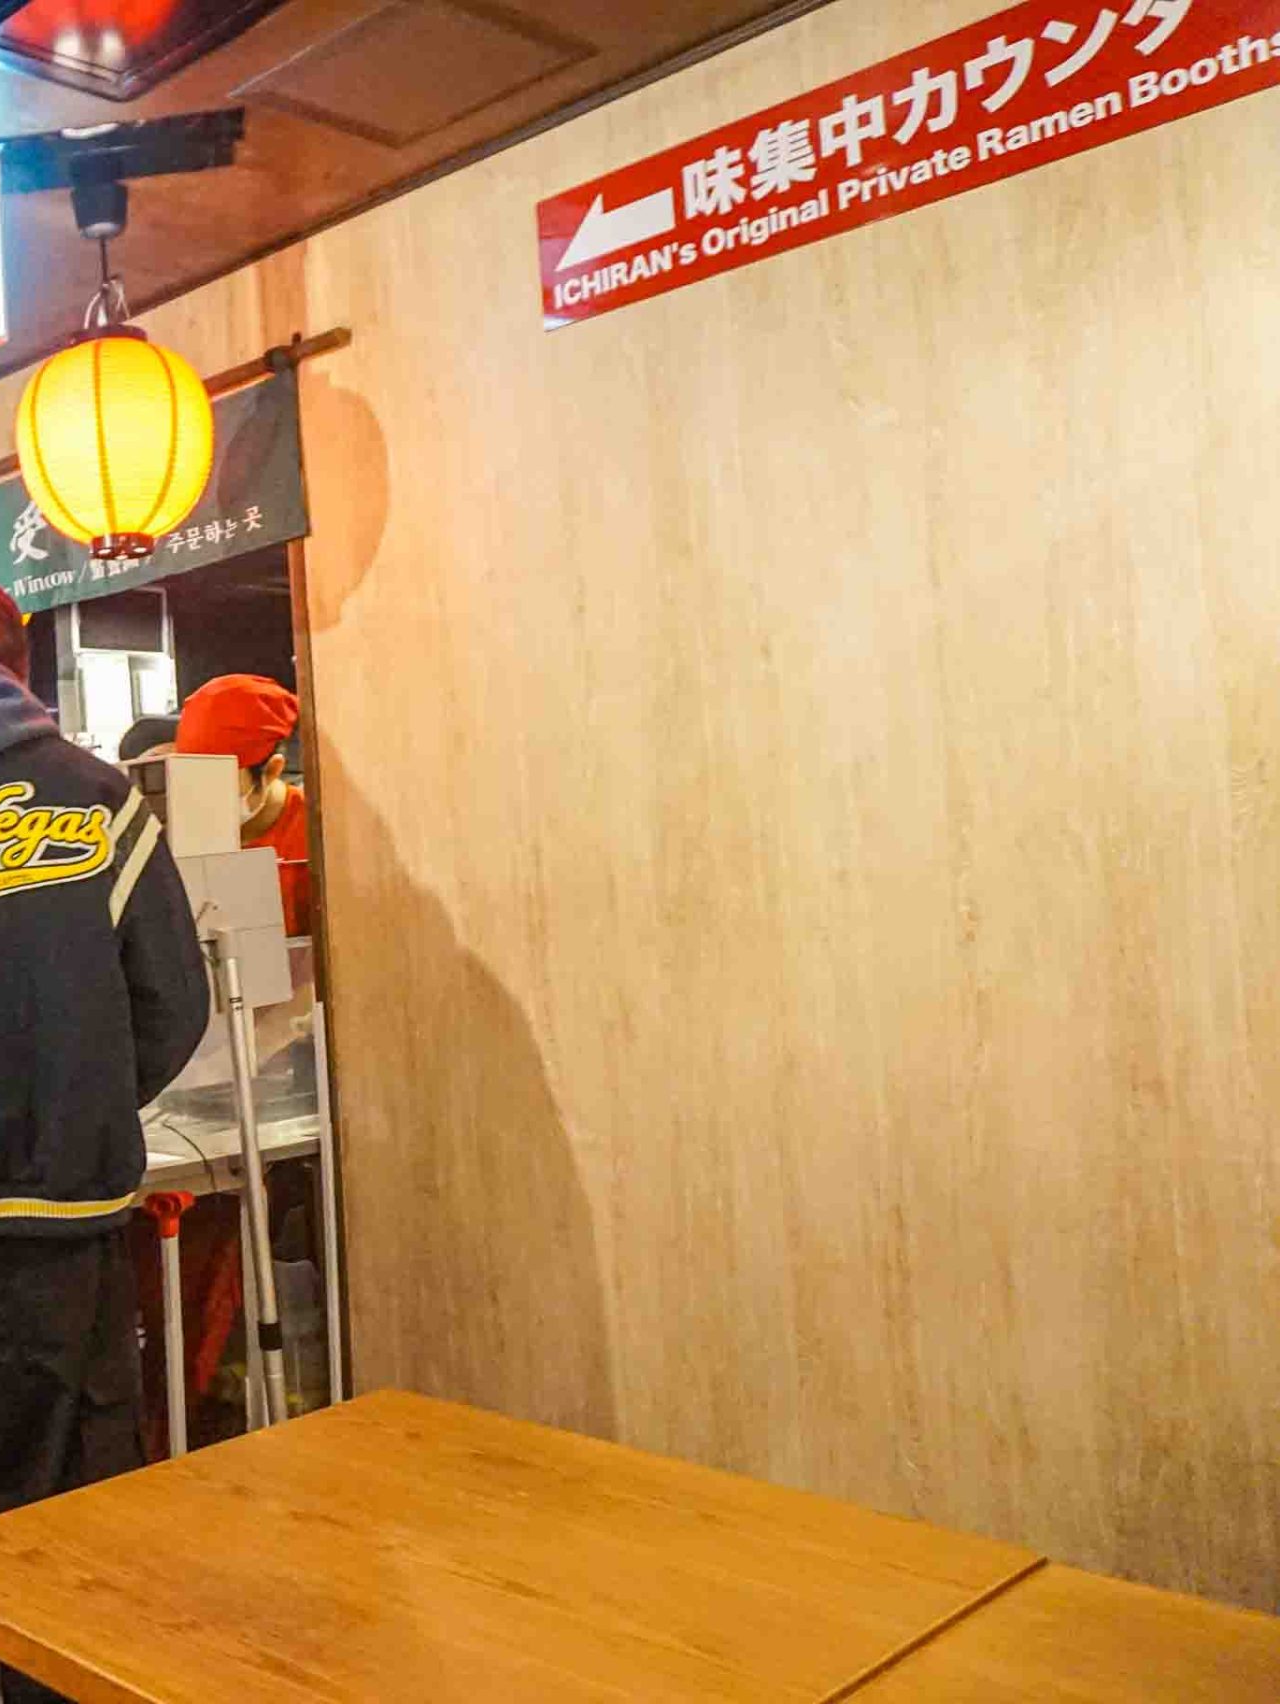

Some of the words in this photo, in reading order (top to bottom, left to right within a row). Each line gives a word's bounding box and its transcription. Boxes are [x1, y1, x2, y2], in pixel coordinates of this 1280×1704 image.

[554, 241, 697, 310] ICHIRAN's
[702, 190, 828, 258] Original
[838, 148, 971, 209] Private
[978, 92, 1122, 159] Ramen
[167, 519, 238, 553] 주문하는
[242, 506, 263, 531] 곳
